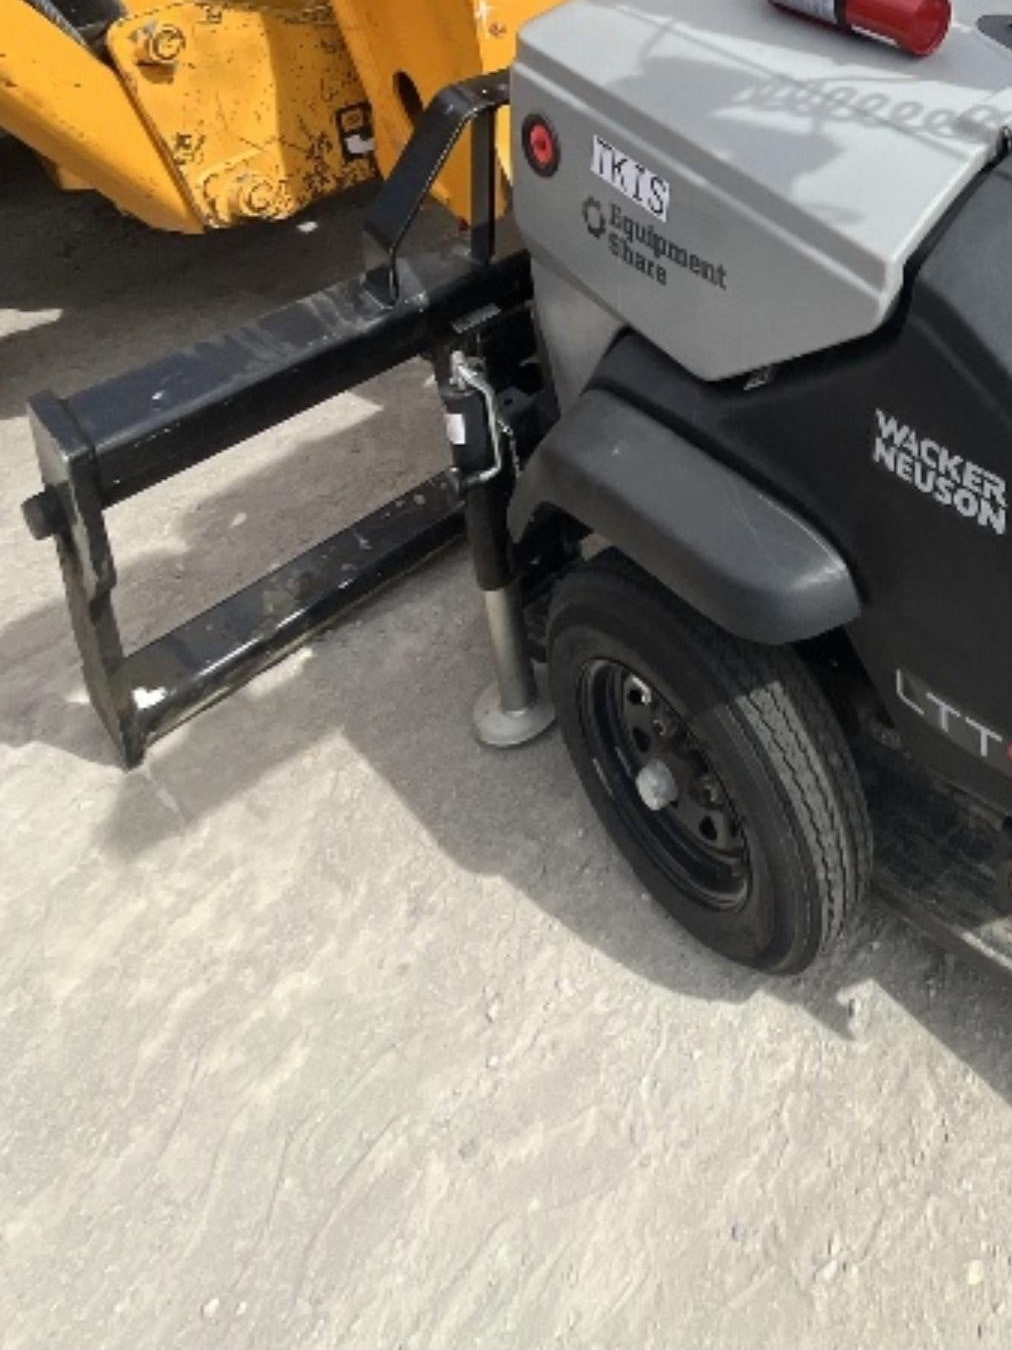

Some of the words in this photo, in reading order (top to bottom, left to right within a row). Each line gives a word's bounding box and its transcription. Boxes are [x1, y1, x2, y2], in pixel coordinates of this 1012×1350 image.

[597, 137, 668, 215] TKIS
[609, 203, 727, 291] Equipment
[873, 437, 1007, 535] NEUSON
[875, 407, 1008, 508] WACKER
